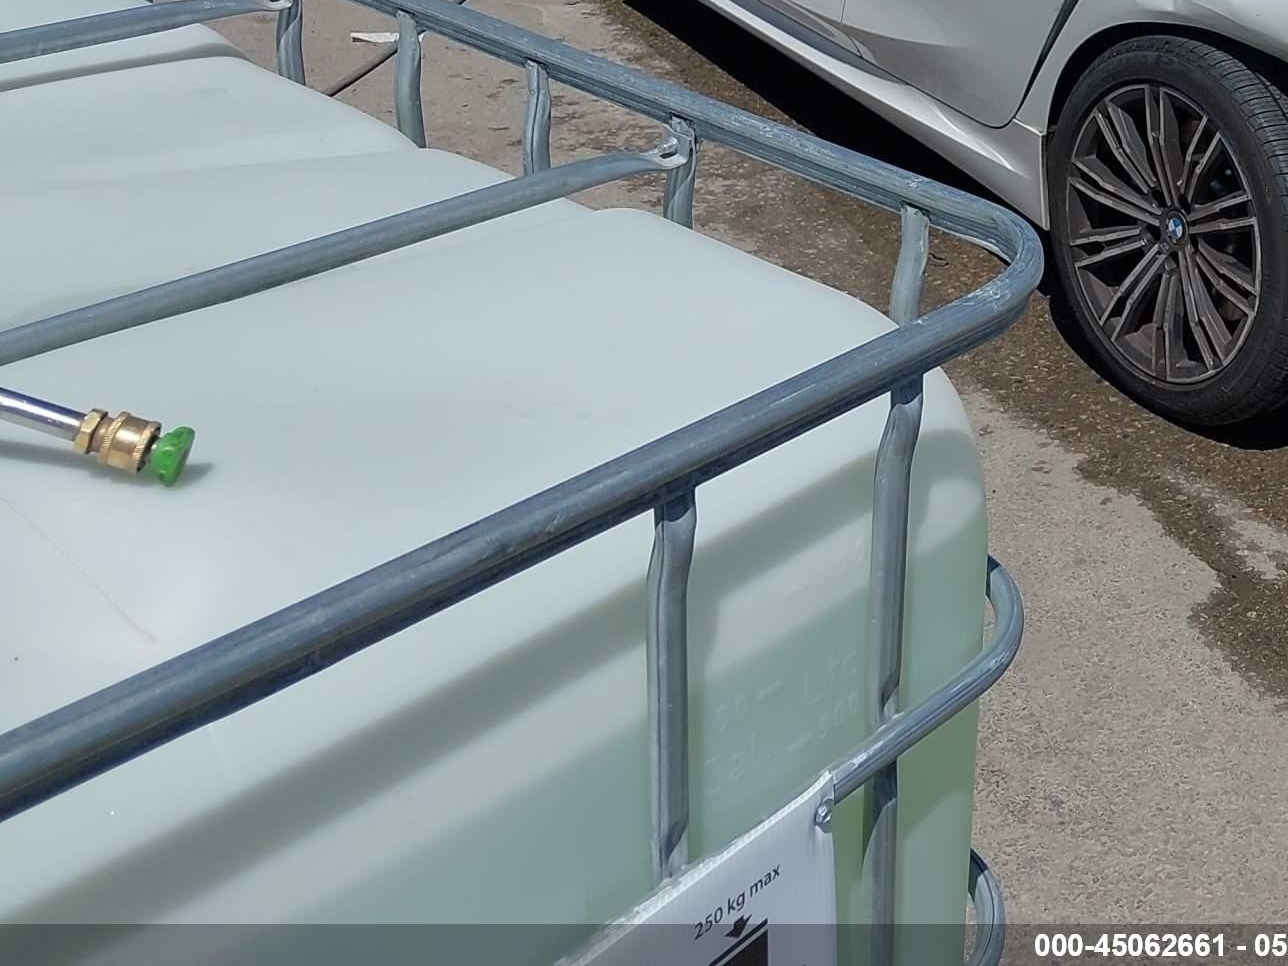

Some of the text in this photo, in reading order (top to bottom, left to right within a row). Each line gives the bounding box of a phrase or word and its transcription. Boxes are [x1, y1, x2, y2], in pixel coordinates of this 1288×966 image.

[694, 865, 781, 941] 250 kg max
